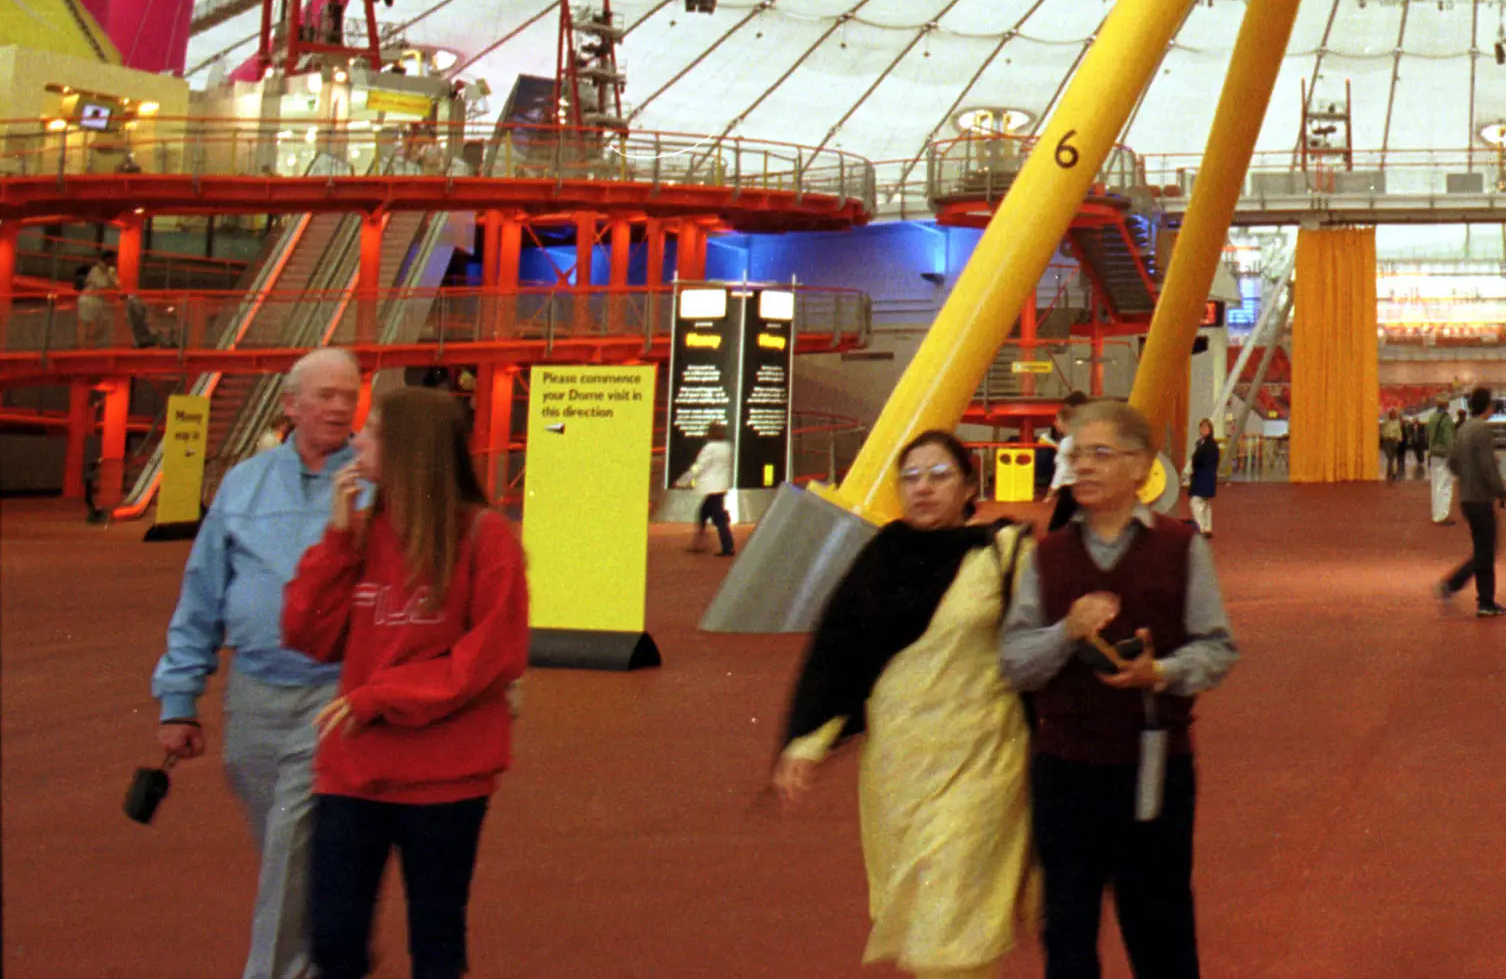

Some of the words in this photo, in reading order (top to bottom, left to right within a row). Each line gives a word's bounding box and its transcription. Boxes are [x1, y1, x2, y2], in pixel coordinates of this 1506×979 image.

[1055, 129, 1079, 169] 6
[543, 372, 577, 383] Please
[580, 373, 641, 383] commence
[543, 391, 565, 403] your
[568, 388, 604, 400] Dome
[607, 389, 629, 400] visit
[632, 389, 642, 401] in
[542, 405, 560, 417] this
[563, 405, 614, 417] direction
